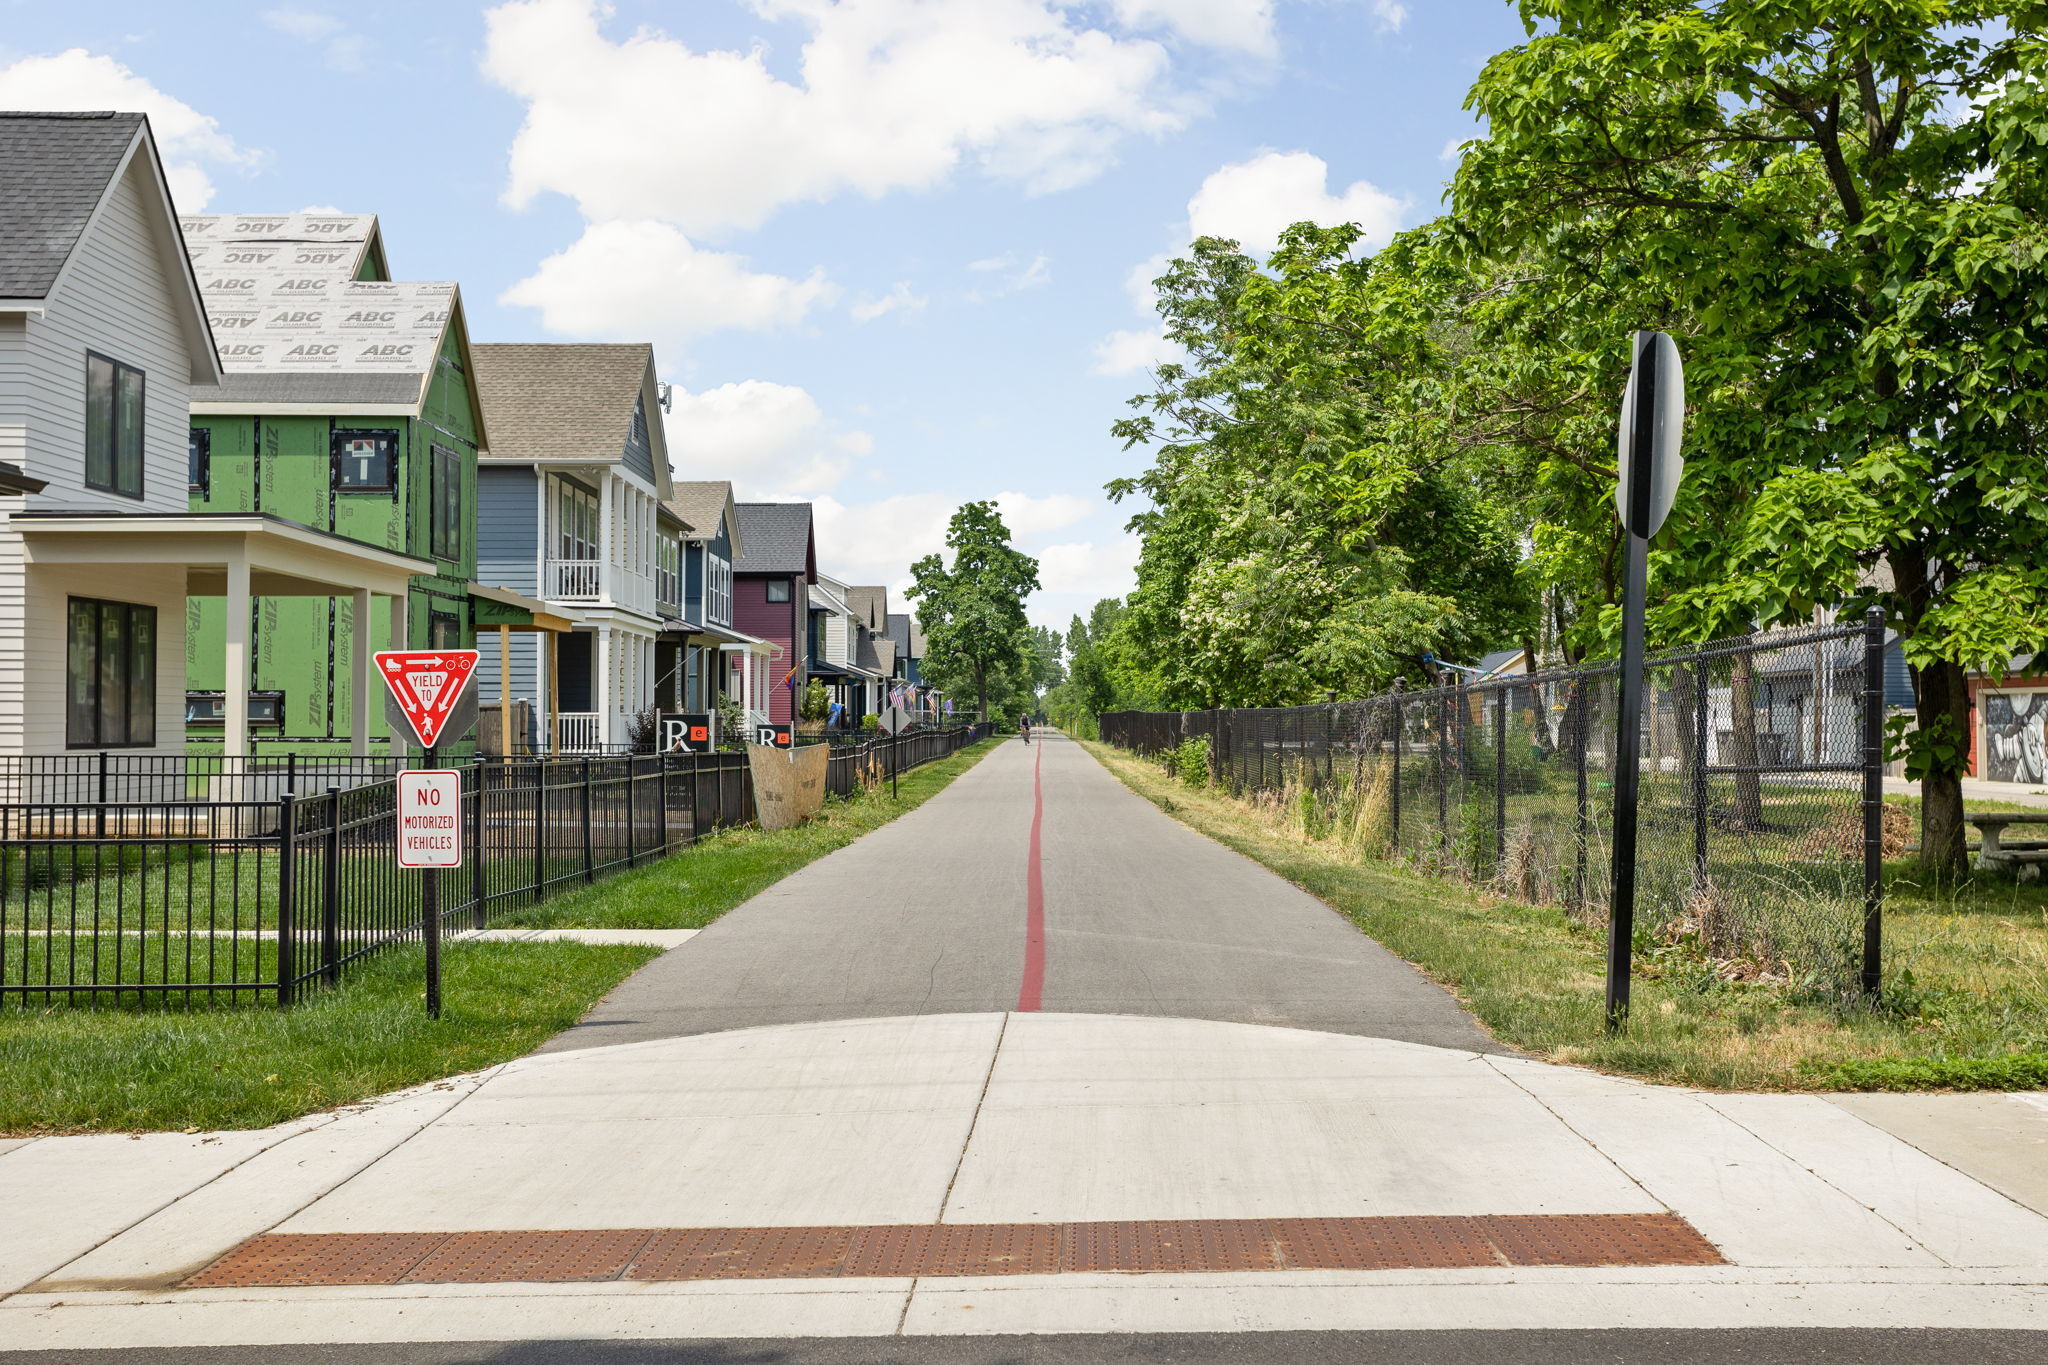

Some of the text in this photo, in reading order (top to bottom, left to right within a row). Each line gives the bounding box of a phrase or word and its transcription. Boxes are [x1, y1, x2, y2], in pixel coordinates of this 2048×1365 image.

[234, 223, 284, 232] ABC
[304, 224, 354, 233] ABC
[224, 253, 275, 263] ABC
[295, 254, 345, 264] ABC
[206, 279, 257, 289] ABC
[277, 279, 328, 289] ABC
[270, 311, 323, 322] ABC
[344, 311, 395, 322] ABC
[209, 317, 257, 328] ABC
[217, 344, 265, 355] ABC
[286, 344, 339, 355] ABC
[361, 344, 413, 355] ABC
[412, 675, 443, 687] YIELD
[421, 690, 432, 701] TO
[417, 788, 441, 806] NO
[405, 815, 454, 829] MOTORIZED
[407, 836, 452, 850] VEHICLES
